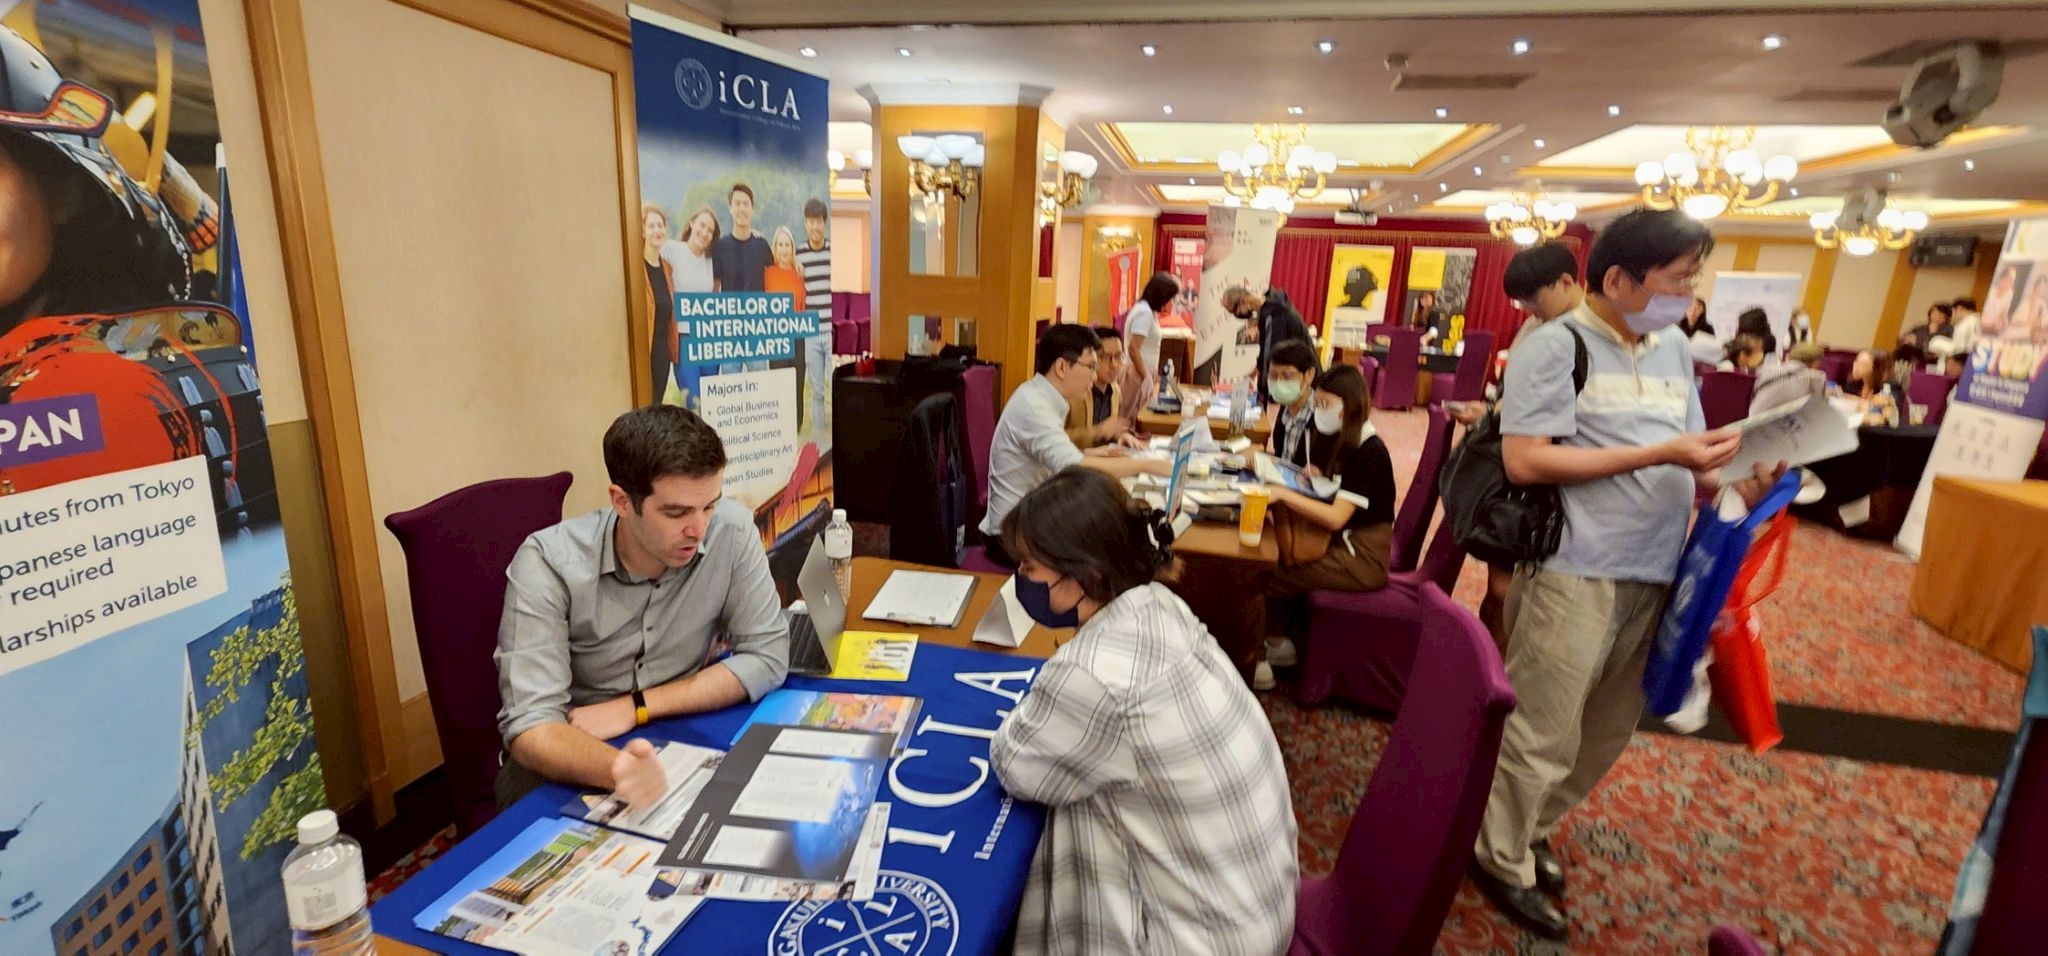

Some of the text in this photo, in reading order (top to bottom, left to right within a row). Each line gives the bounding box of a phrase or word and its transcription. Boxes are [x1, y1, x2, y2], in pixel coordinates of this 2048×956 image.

[719, 70, 801, 121] iCLA
[680, 296, 790, 317] BACHELOR OF
[696, 317, 816, 339] INTERNATIONAL
[688, 338, 790, 362] LIBERAL ARTS
[707, 380, 759, 398] Majors in:
[716, 399, 779, 416] Global Business
[717, 411, 779, 428] and Economics
[0, 408, 84, 455] PAN
[721, 428, 782, 448] olitical Science
[727, 447, 781, 465] erdisciplinary
[745, 467, 774, 480] Studies
[0, 477, 195, 536] utes from Tokyo
[0, 514, 197, 587] panese language
[10, 557, 114, 606] required
[0, 574, 198, 654] larships available
[973, 797, 1014, 860] Internati
[875, 875, 951, 930] IVERSITY
